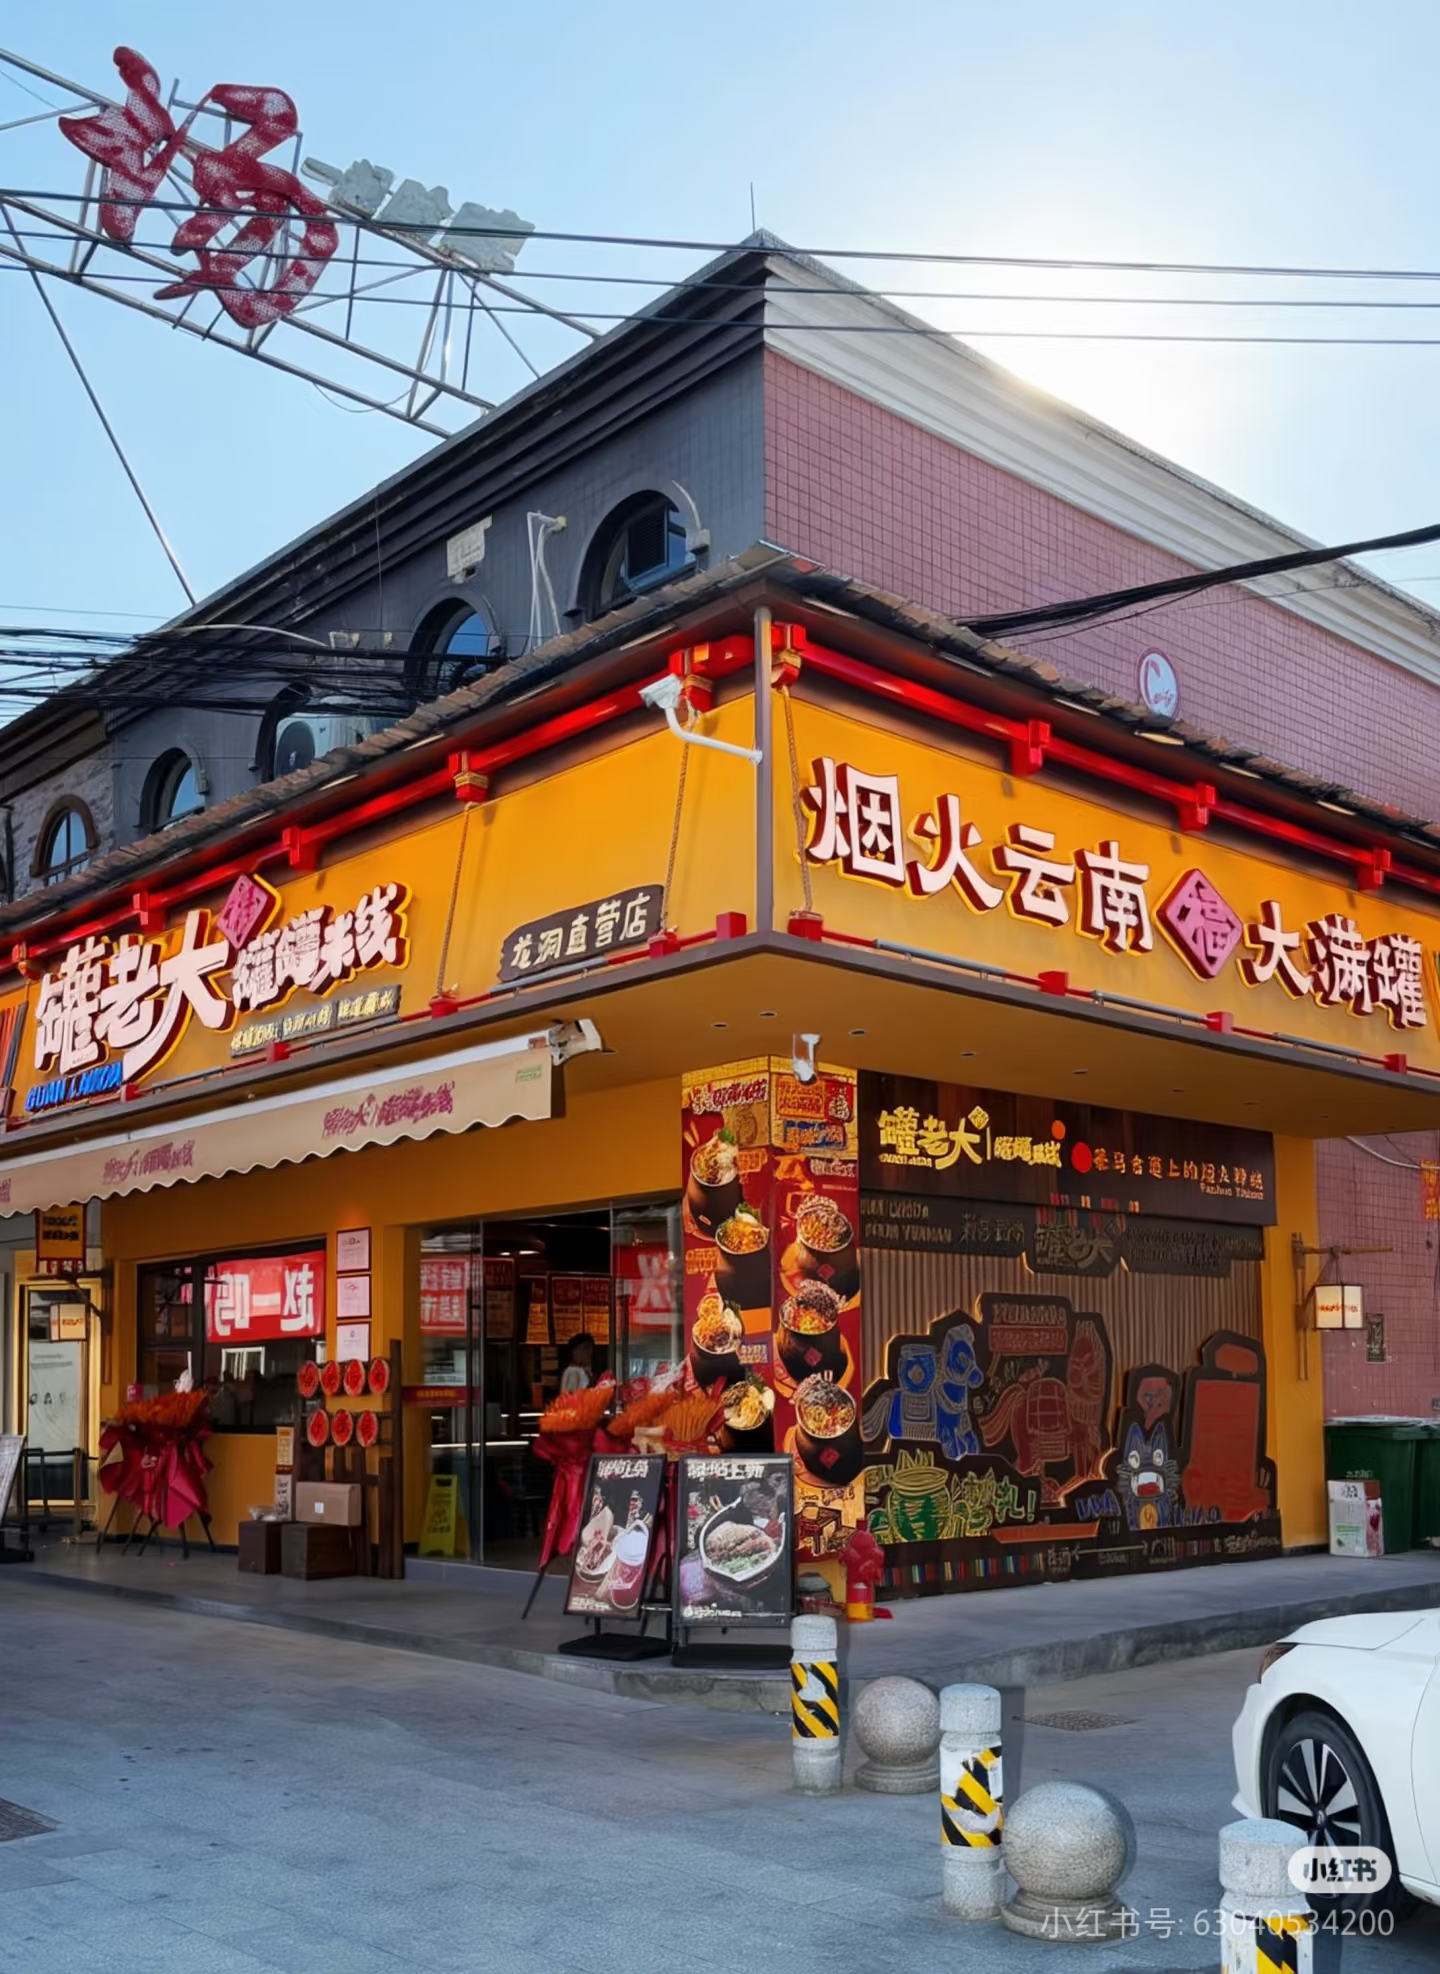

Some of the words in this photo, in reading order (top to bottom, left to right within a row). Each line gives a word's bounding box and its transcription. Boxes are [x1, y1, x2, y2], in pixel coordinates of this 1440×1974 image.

[511, 892, 650, 969] 龙洞直营店
[803, 757, 1154, 954] 烟火云南
[1250, 900, 1428, 1029] 大满罐
[34, 909, 230, 1082] 罐老大
[878, 1106, 983, 1170] 罐老大
